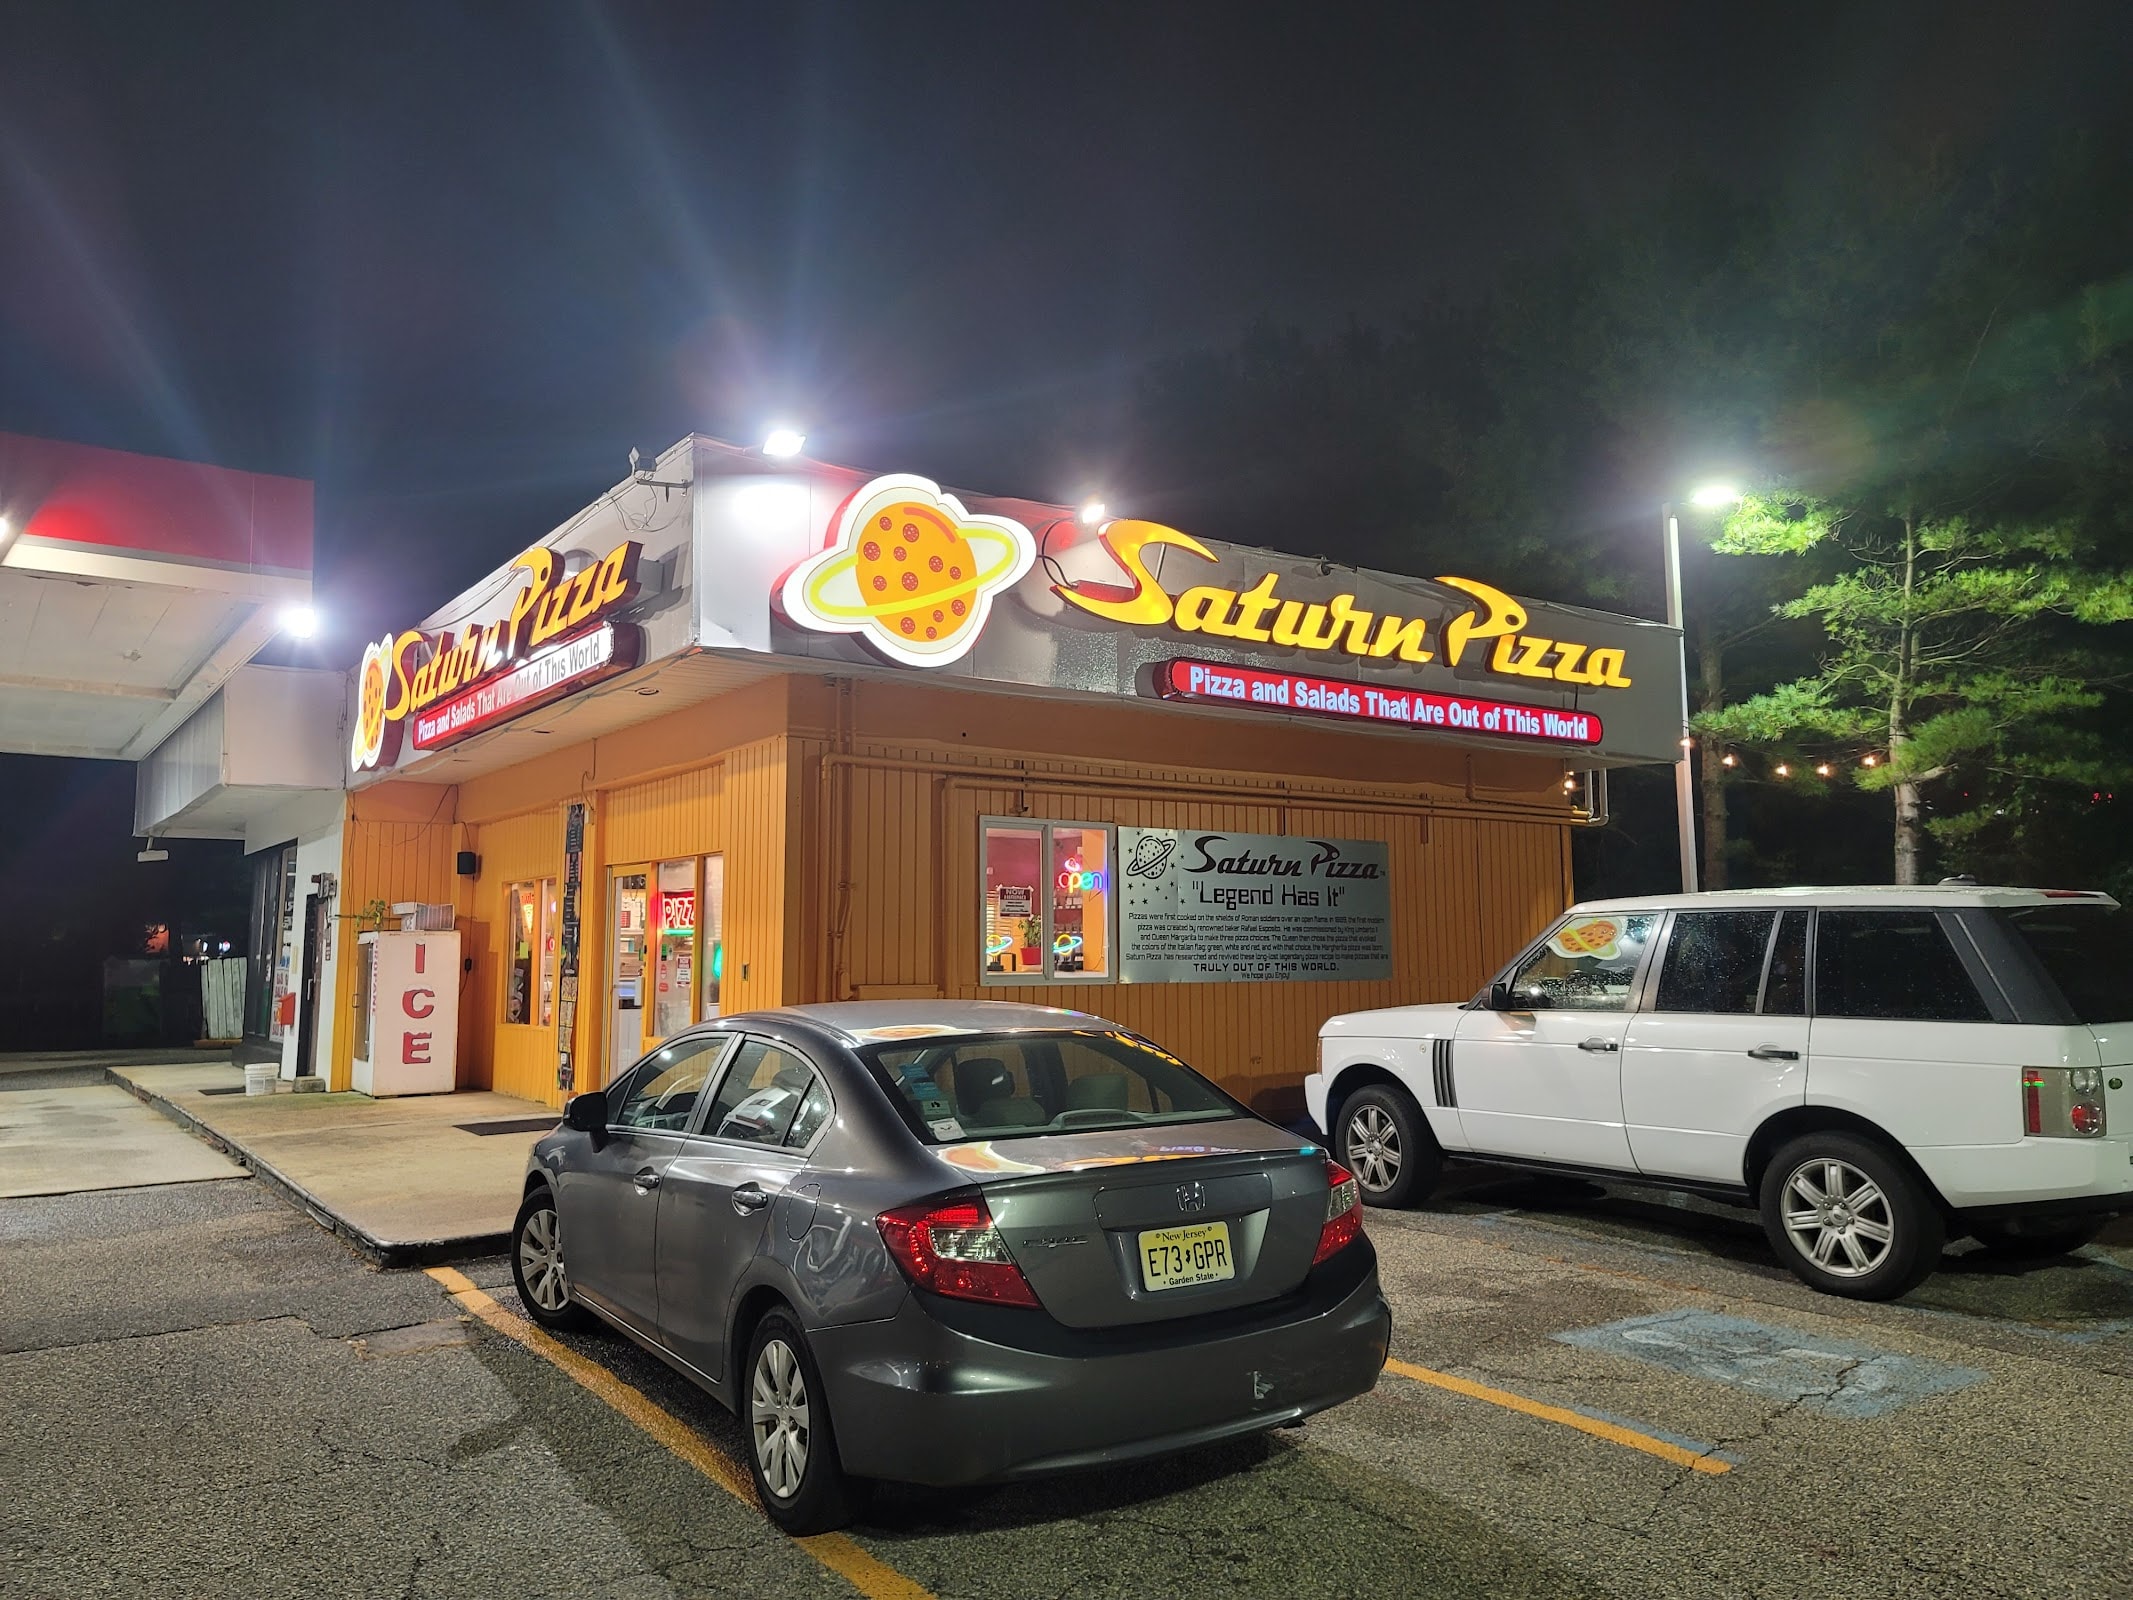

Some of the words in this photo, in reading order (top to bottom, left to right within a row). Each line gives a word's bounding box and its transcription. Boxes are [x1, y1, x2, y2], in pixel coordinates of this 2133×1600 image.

[1050, 519, 1433, 663] Saturn
[1434, 575, 1632, 688] Pizza
[383, 619, 502, 721] Saturn
[508, 544, 629, 660] Pizza
[418, 716, 436, 743] Pizza
[436, 708, 450, 734] and
[450, 697, 476, 729] Salads
[477, 687, 495, 716] That
[496, 680, 512, 707] Are
[532, 662, 543, 689] of
[545, 655, 566, 685] This
[568, 633, 600, 674] World
[1190, 665, 1244, 700] Pizza
[1251, 677, 1290, 703] and
[1295, 680, 1361, 714] Salads
[1367, 688, 1408, 720] That
[1412, 696, 1444, 724] Are
[1450, 700, 1478, 726] Out
[1483, 705, 1502, 731] of
[1505, 707, 1540, 735] This
[1543, 712, 1588, 742] World
[1182, 835, 1303, 878] Saturn
[1306, 840, 1380, 879] Pizza
[1058, 871, 1103, 893] open
[1191, 880, 1274, 911] "Legend
[1281, 884, 1320, 907] Has
[1326, 886, 1346, 908] It"
[1128, 912, 1148, 920] Pizzas
[1165, 912, 1176, 921] first
[1177, 913, 1197, 921] cooked
[1215, 914, 1234, 922] shields
[1235, 914, 1241, 922] of
[1137, 924, 1153, 932] pizza
[1189, 924, 1196, 933] by
[1151, 933, 1170, 941] Queen
[1235, 935, 1249, 943] pizza
[1272, 934, 1281, 942] The
[1282, 934, 1299, 942] Queen
[1131, 943, 1141, 951] the
[1141, 943, 1159, 951] colors
[1160, 943, 1167, 951] of
[1125, 953, 1146, 961] Saturn
[1146, 953, 1162, 961] Pizza
[1163, 953, 1174, 961] has
[1240, 953, 1255, 961] these
[1193, 962, 1230, 973] TRULY
[1233, 962, 1254, 972] OUT
[1257, 962, 1271, 972] OF
[1274, 962, 1298, 972] THIS
[1301, 962, 1340, 972] WORLD.
[1250, 972, 1264, 980] hope
[402, 939, 436, 1064] ICE
[1162, 1230, 1181, 1241] New
[1182, 1227, 1208, 1242] Jersey
[1168, 1274, 1194, 1287] Garden
[1195, 1271, 1215, 1284] State
